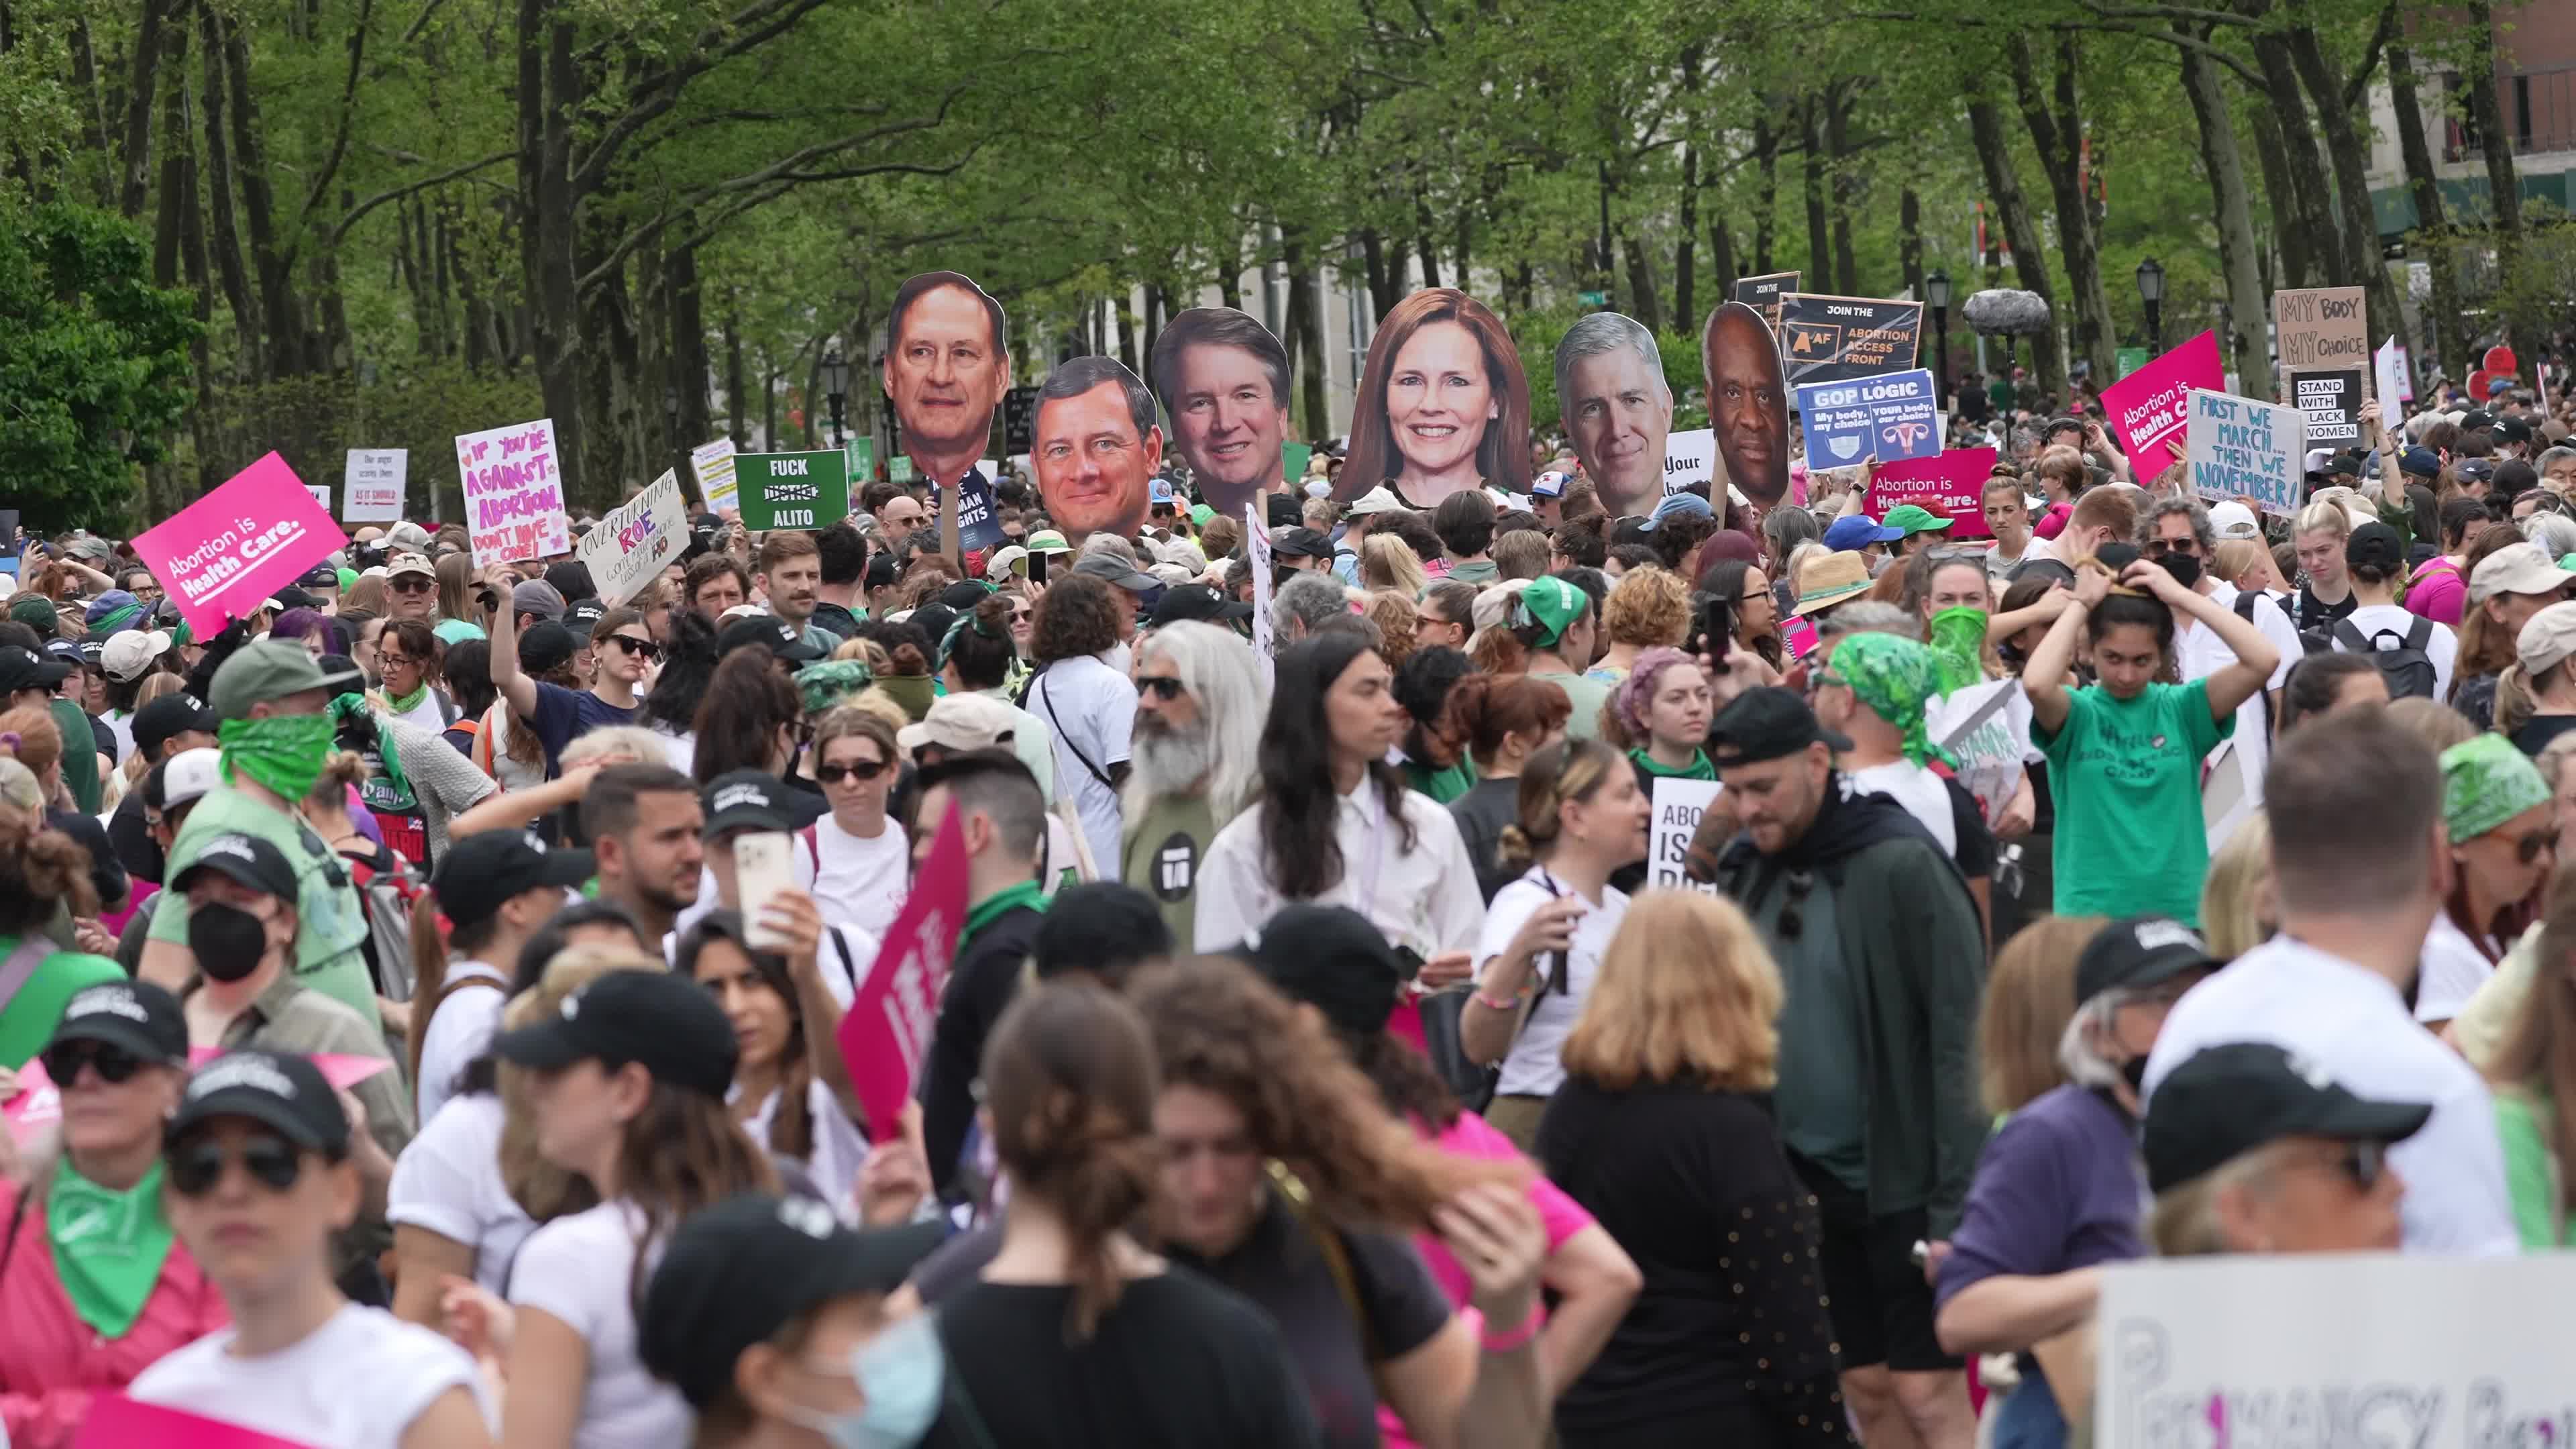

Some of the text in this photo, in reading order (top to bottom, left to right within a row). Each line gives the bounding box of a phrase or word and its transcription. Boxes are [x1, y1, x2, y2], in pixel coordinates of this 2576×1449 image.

[1756, 283, 1778, 294] JOIN THE
[1827, 305, 1874, 317] JOIN THE
[2280, 293, 2360, 322] MY BODY
[1846, 341, 1894, 353] ACCESS
[1847, 328, 1911, 341] ABORTION
[1845, 354, 1884, 366] FRONT
[2284, 331, 2318, 366] MY
[1815, 382, 1919, 408] GOP LOGIC
[2300, 381, 2342, 392] STAND
[1872, 405, 1902, 416] YOUR
[2124, 388, 2176, 429] Abortion
[2176, 380, 2189, 396] is
[2200, 396, 2239, 421] FIRST
[2247, 406, 2273, 430] WE
[2301, 397, 2334, 409] WITH
[1814, 419, 1871, 432] my choice
[1815, 413, 1833, 423] My
[1878, 411, 1931, 423] our choice
[2129, 409, 2174, 447] Health
[2309, 411, 2343, 423] LACK
[472, 429, 548, 462] IF YOU'RE
[769, 460, 809, 477] FUCK
[2212, 445, 2287, 478] THEN WE
[467, 453, 549, 497] AGAINST
[1875, 476, 1953, 492] Abortion is
[2195, 461, 2298, 510] NOVEMBER!
[584, 473, 673, 556] OVERTURNING
[773, 509, 814, 527] ALITO
[472, 527, 511, 552] DON'T
[618, 508, 657, 555] ROE
[168, 517, 256, 579] Abortion is
[180, 520, 299, 598] Health Care.
[1660, 832, 1688, 863] IS
